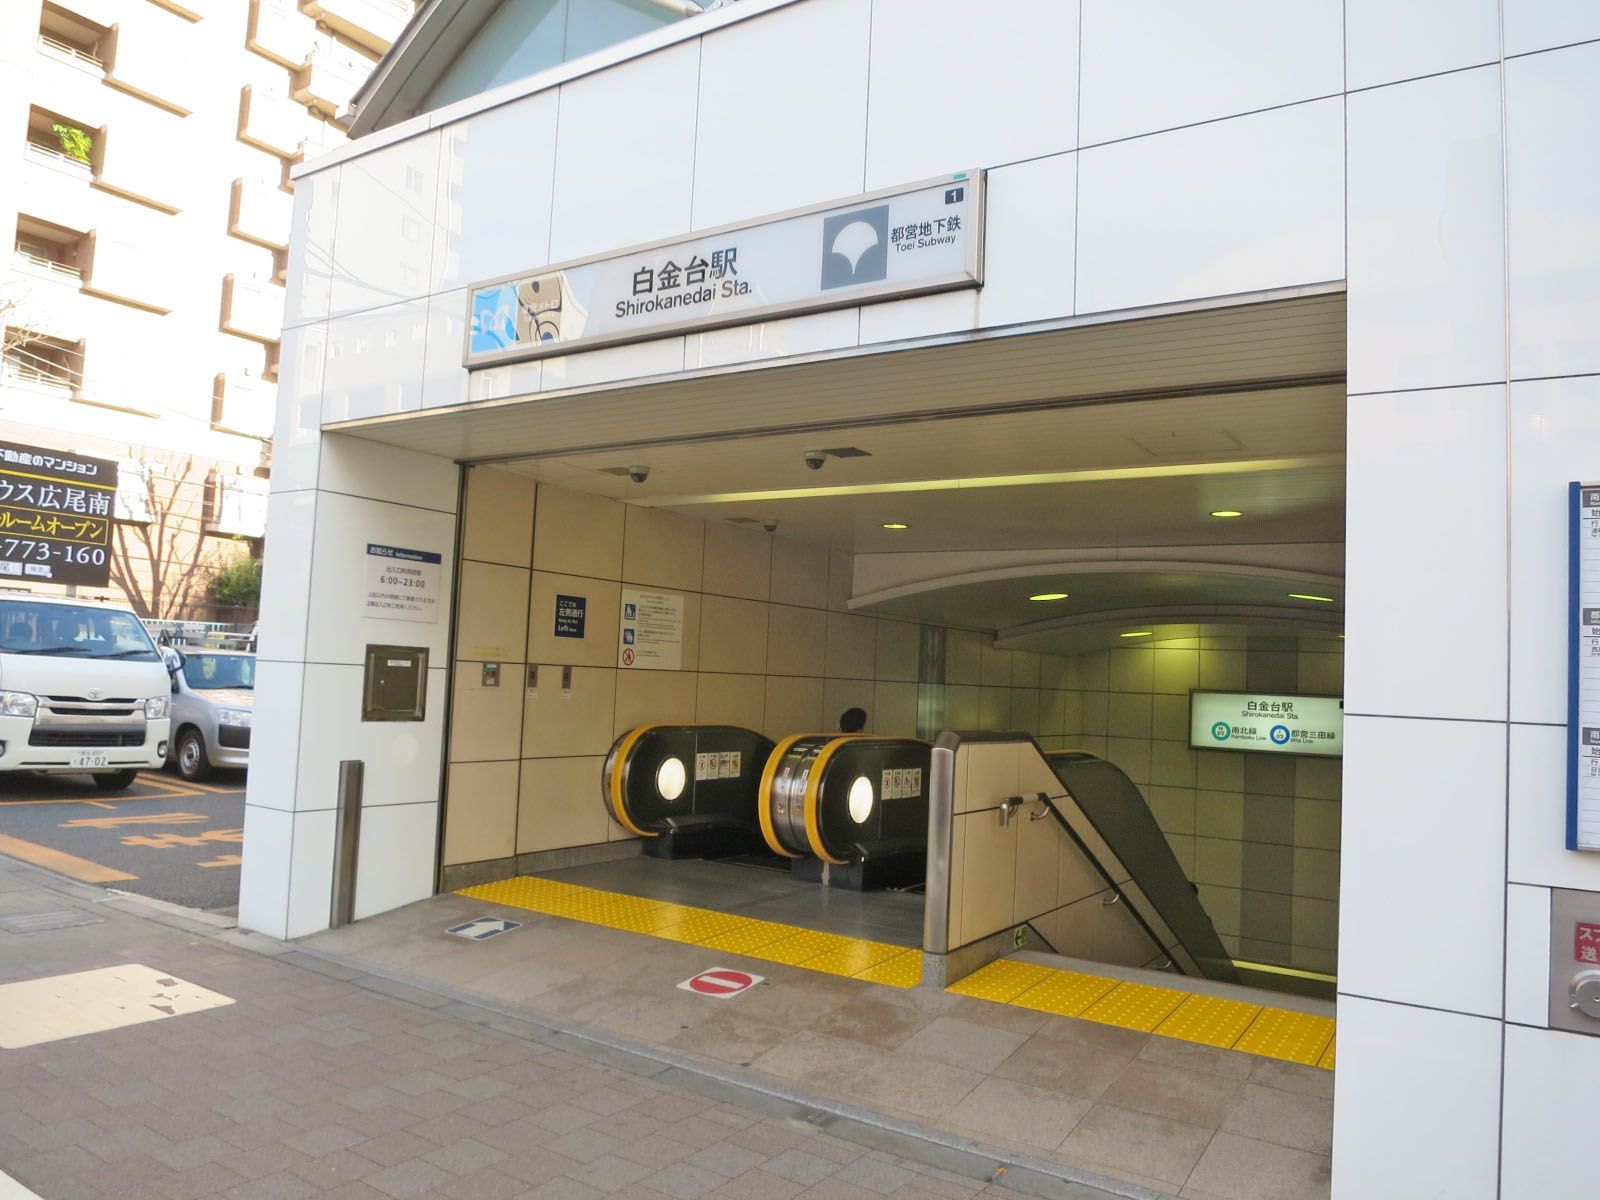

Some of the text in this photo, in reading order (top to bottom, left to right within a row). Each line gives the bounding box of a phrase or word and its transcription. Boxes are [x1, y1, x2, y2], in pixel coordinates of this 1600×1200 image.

[951, 190, 957, 203] 1
[891, 215, 961, 243] 都営地下鉄
[896, 235, 956, 253] Toei Subway
[632, 247, 737, 296] 白金台駅
[615, 280, 752, 318] Shirokanedai Sta.
[559, 608, 584, 618] 左側通行
[1247, 701, 1293, 712] 白金台駅
[1241, 711, 1285, 719] Shirokanedai
[1231, 726, 1257, 735] 南北線
[1291, 730, 1335, 740] 都営三田線
